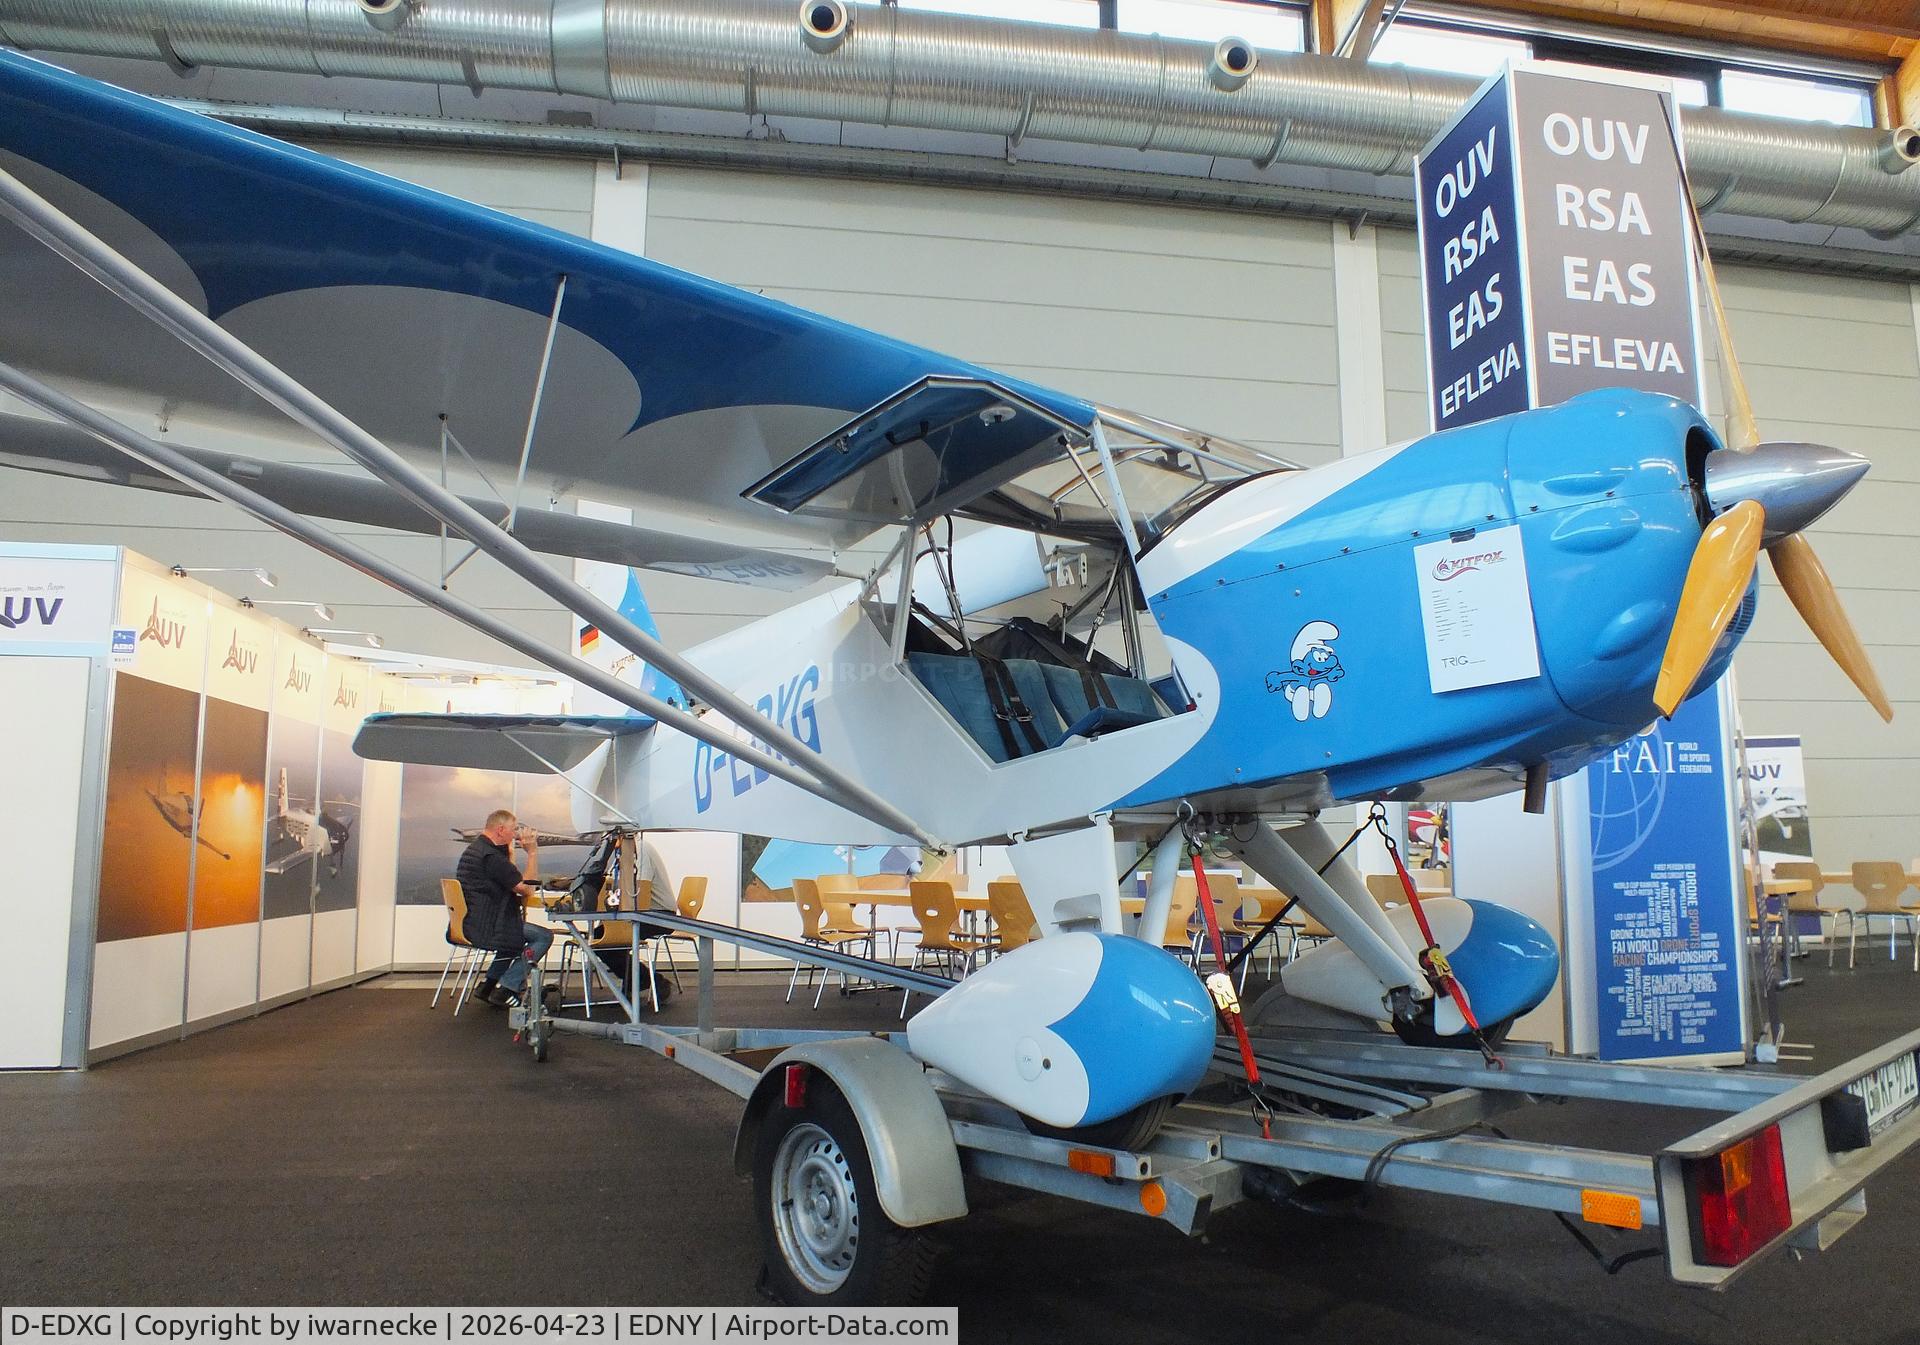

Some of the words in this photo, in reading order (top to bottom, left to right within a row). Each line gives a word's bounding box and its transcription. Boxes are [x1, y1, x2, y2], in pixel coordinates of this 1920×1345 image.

[1543, 112, 1649, 164] OUV
[1435, 126, 1496, 218] OUV
[1556, 184, 1652, 235] RSA
[1444, 205, 1499, 284] RSA
[1563, 255, 1656, 307] EAS
[1449, 272, 1503, 351] EAS
[1547, 331, 1684, 374] EFLEVA
[1441, 342, 1521, 419] EFLEVA
[1449, 550, 1503, 569] KITFOX
[0, 597, 63, 628] UV
[1441, 655, 1469, 668] TRIG
[1612, 740, 1676, 773] FAI
[1661, 881, 1671, 937] MULTI-ROTOR
[1686, 871, 1698, 906] DRONE
[1612, 940, 1626, 954] FAI
[1626, 939, 1659, 953] WORLD
[1660, 939, 1689, 951] DRONE
[1688, 908, 1700, 948] SPORTS
[1613, 953, 1646, 967] RACING
[1647, 950, 1718, 966] CHAMPIONSHIPS
